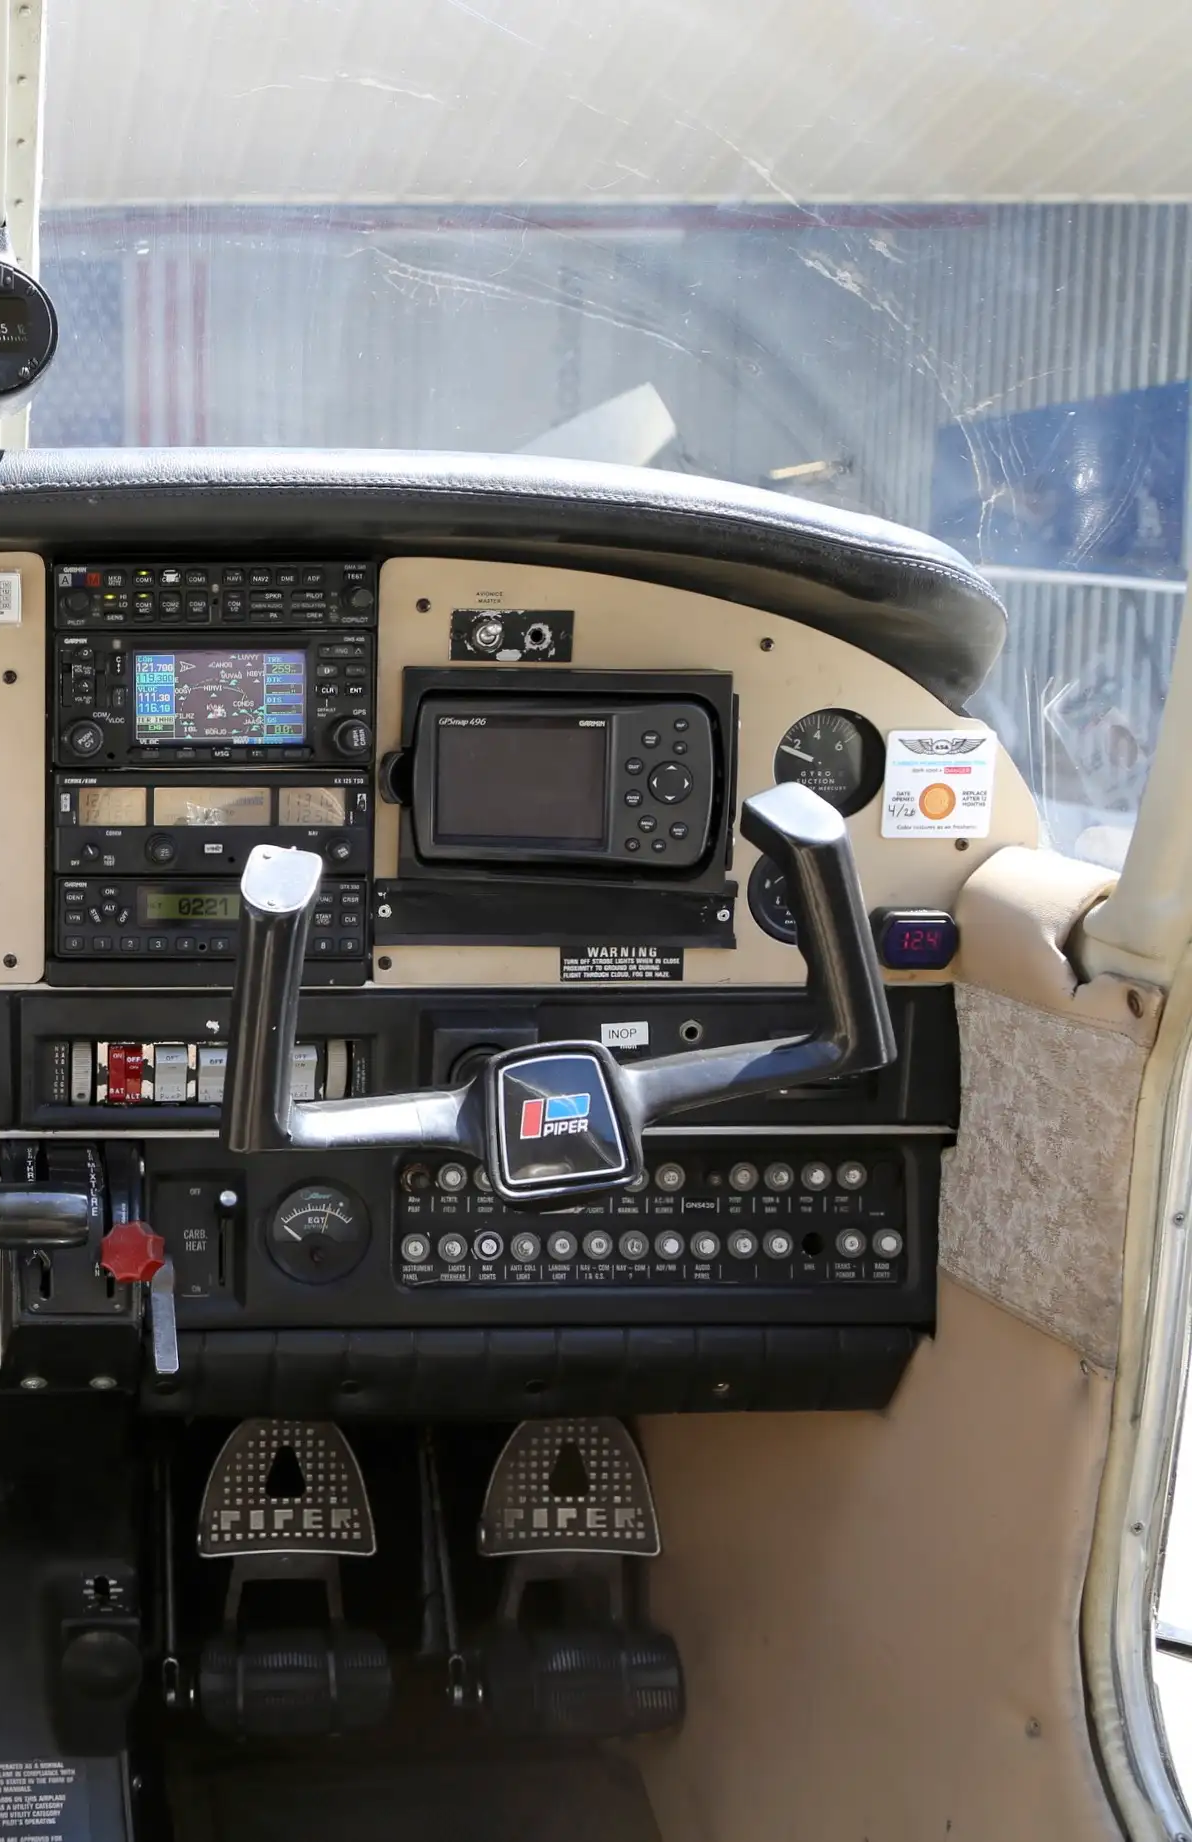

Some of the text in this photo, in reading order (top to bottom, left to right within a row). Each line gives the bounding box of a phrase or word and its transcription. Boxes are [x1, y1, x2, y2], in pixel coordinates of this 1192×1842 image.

[438, 718, 487, 727] GPSmap 496
[813, 730, 821, 740] 4
[793, 738, 801, 750] 2
[834, 740, 843, 751] 6
[178, 897, 228, 916] 0221
[587, 947, 657, 957] WARNING
[608, 1028, 637, 1040] INOP
[543, 1119, 588, 1137] PIPER
[189, 1188, 202, 1196] OFF
[183, 1230, 208, 1240] CARB.
[185, 1240, 207, 1251] HEAT
[191, 1285, 201, 1293] ON
[220, 1509, 351, 1530] PIPER
[504, 1507, 636, 1528] PIPER
